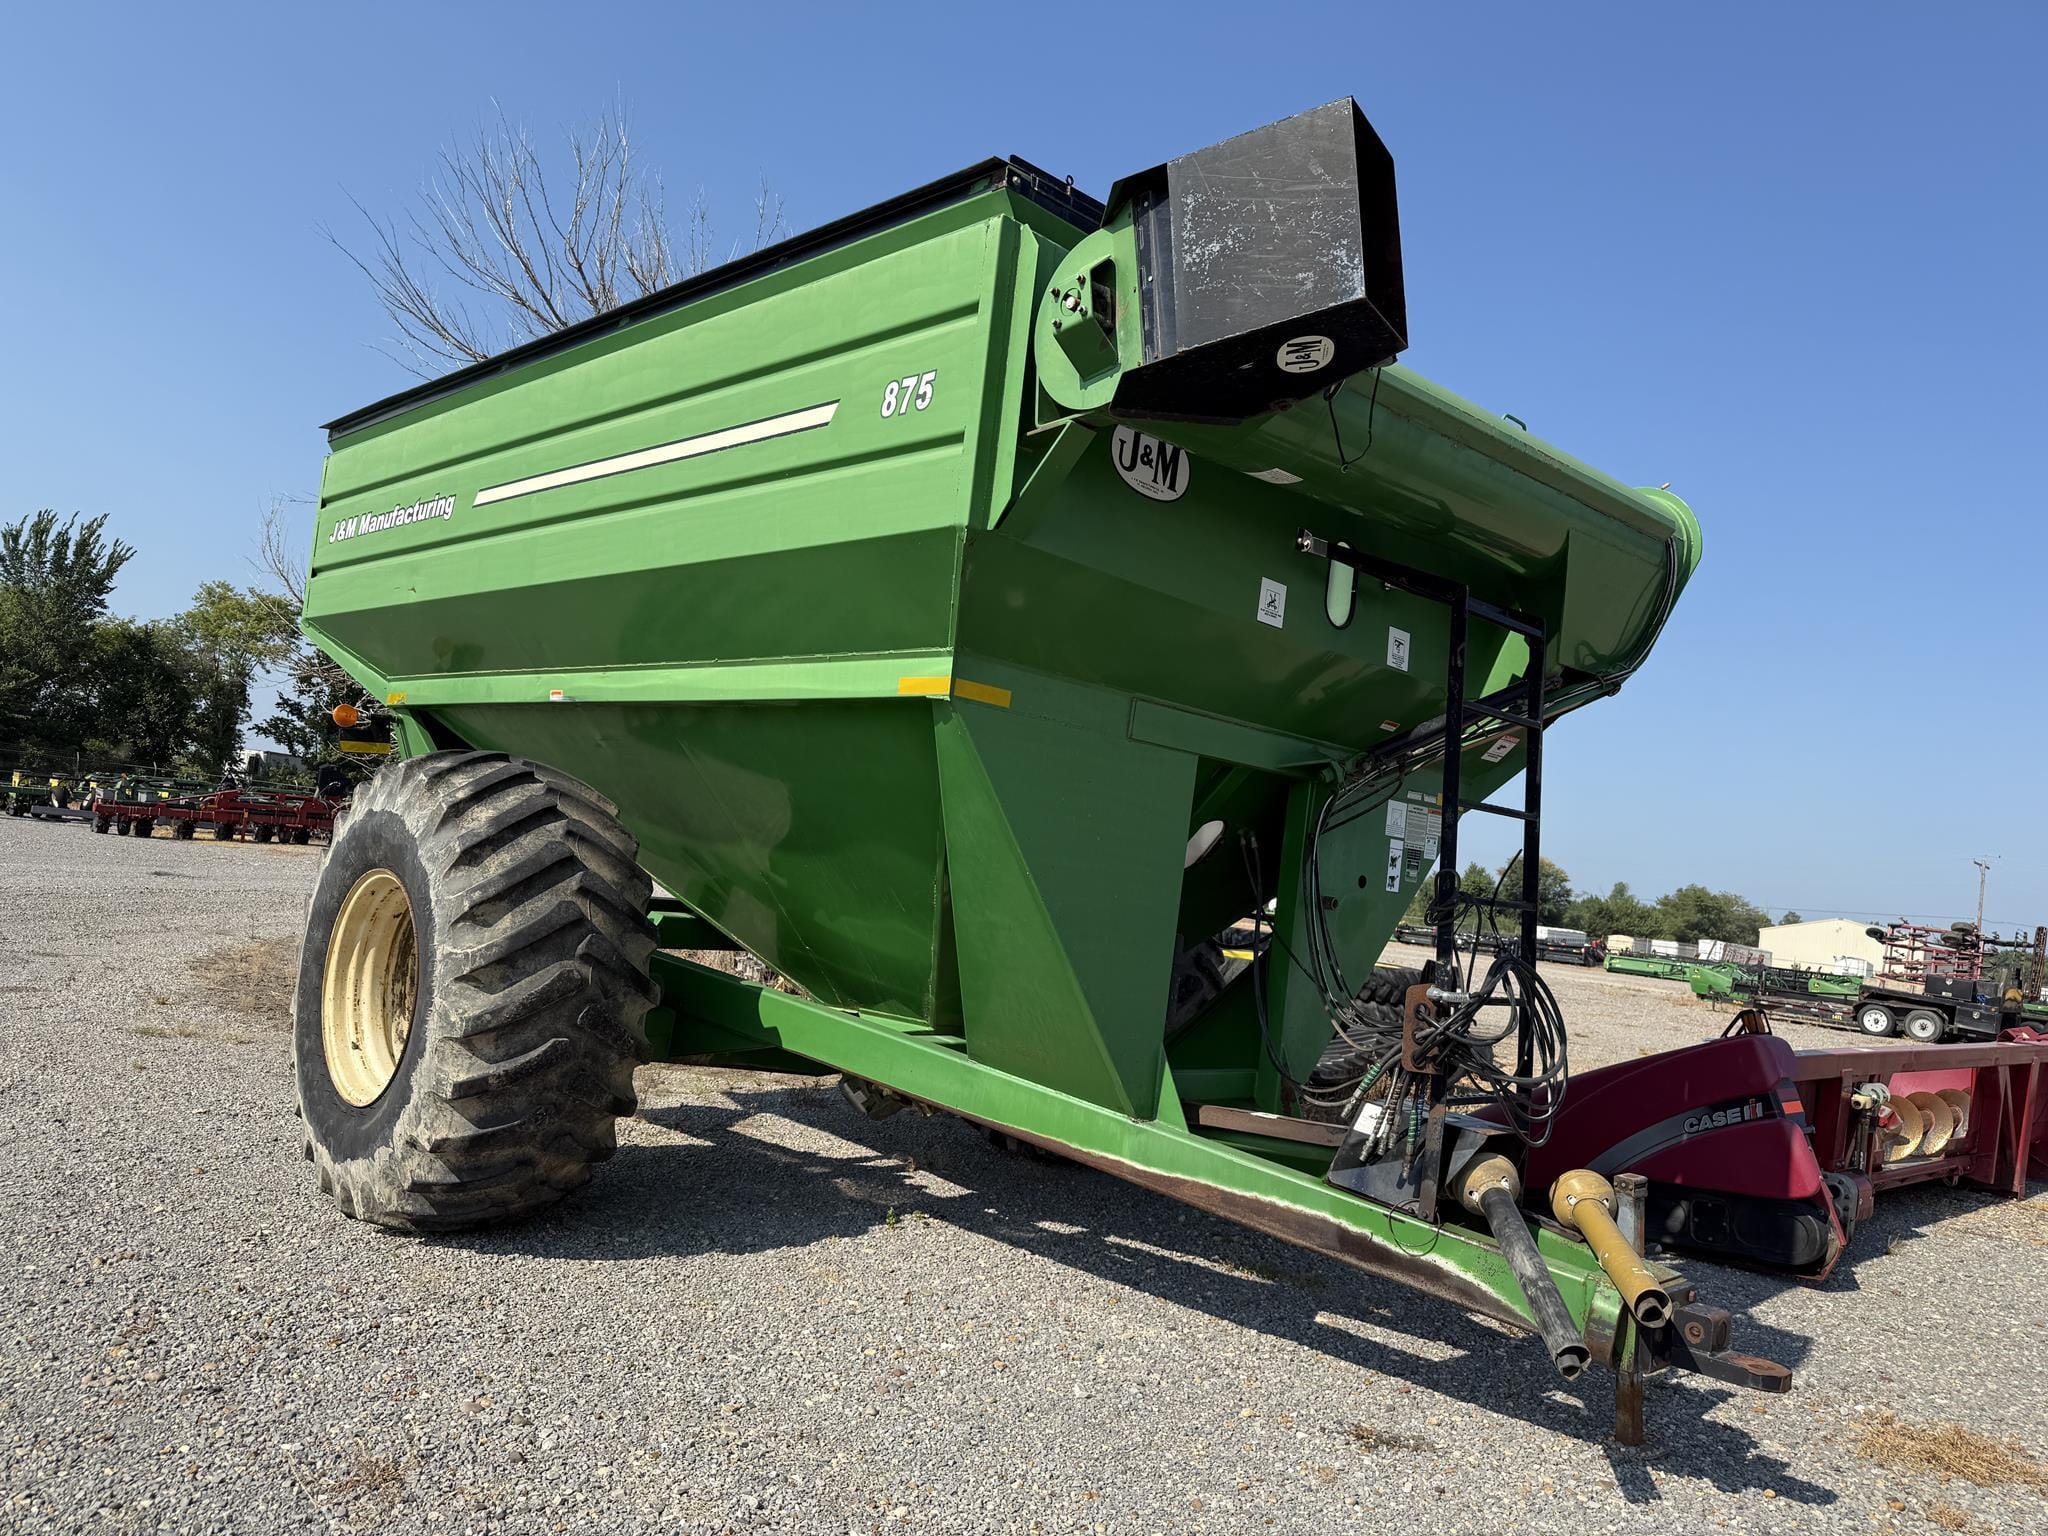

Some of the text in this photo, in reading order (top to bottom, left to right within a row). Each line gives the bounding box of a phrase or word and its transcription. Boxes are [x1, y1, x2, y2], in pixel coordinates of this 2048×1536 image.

[1285, 339, 1322, 370] J&M
[880, 369, 938, 419] 875
[1119, 431, 1183, 493] J&M
[329, 492, 457, 544] J&M Manufacturing
[1684, 1107, 1742, 1133] CASE
